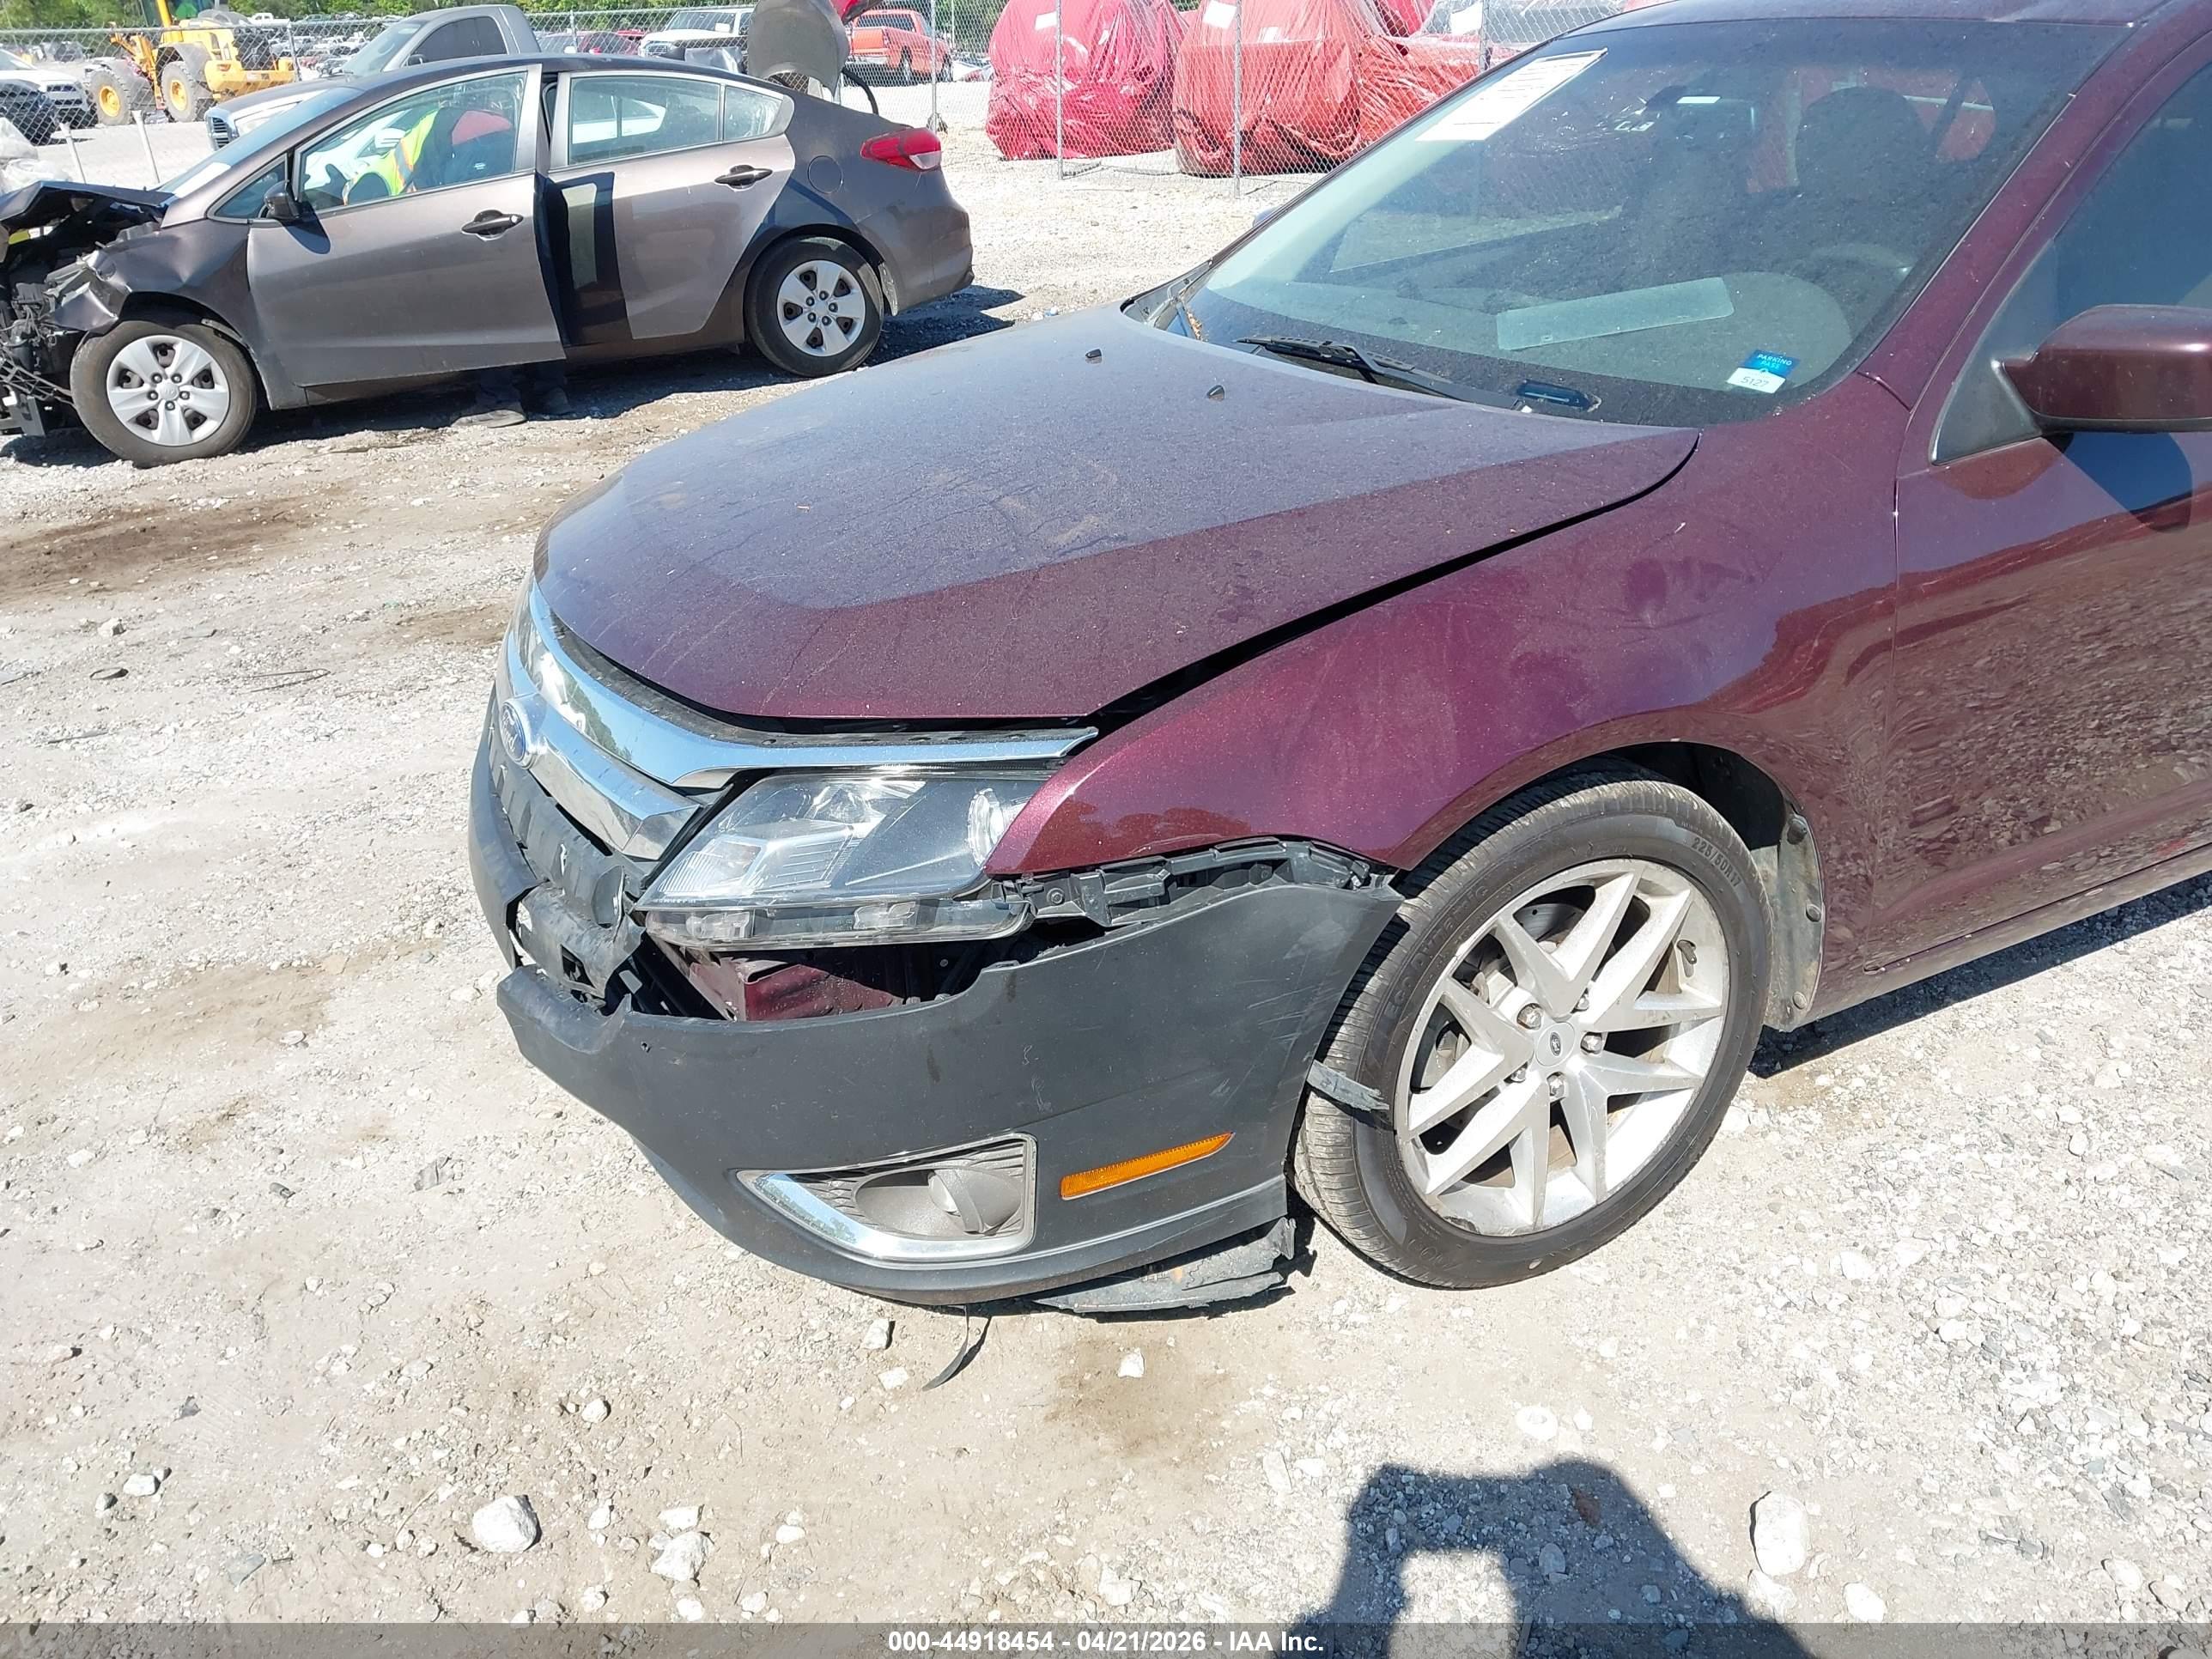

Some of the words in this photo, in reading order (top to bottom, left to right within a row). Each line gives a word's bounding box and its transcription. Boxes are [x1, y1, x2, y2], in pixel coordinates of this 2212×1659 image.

[1757, 353, 1792, 366] PARKING
[1760, 361, 1780, 369] PASS
[1740, 376, 1769, 386] 5127
[1691, 836, 1744, 889] 225/50R17
